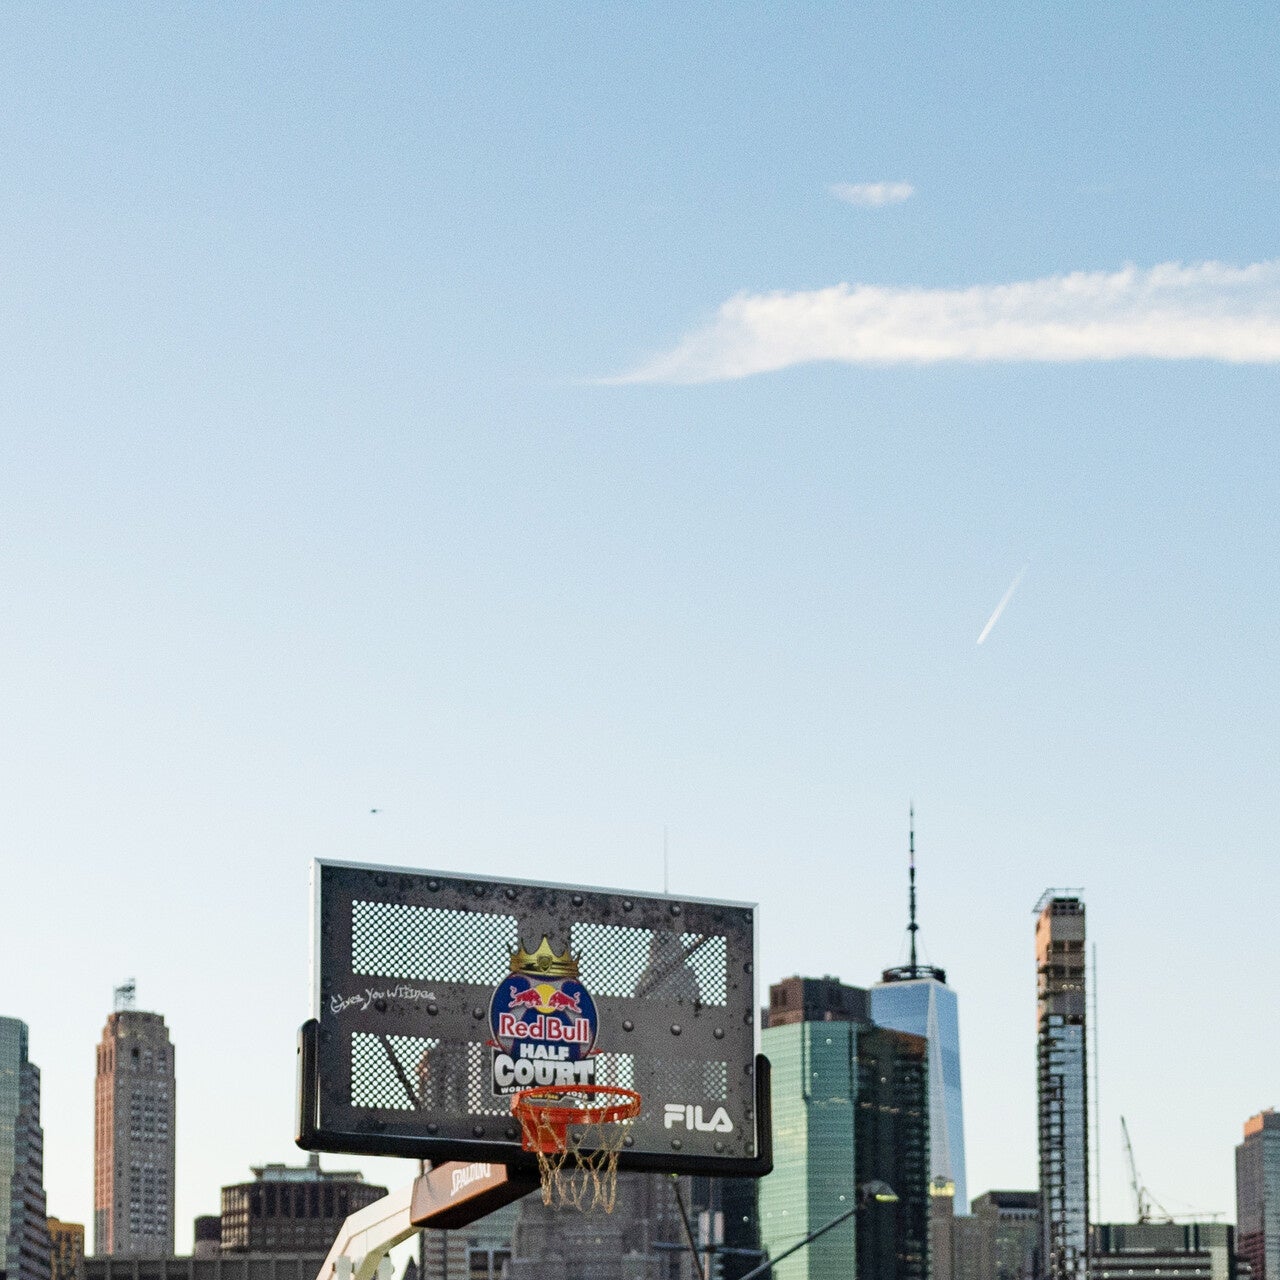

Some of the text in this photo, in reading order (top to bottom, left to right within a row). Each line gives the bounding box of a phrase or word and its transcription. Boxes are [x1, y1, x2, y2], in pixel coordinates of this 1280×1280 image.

[499, 1012, 589, 1043] Red Bull
[520, 1043, 570, 1061] HALF
[494, 1053, 595, 1087] COURT
[663, 1103, 734, 1133] FILA
